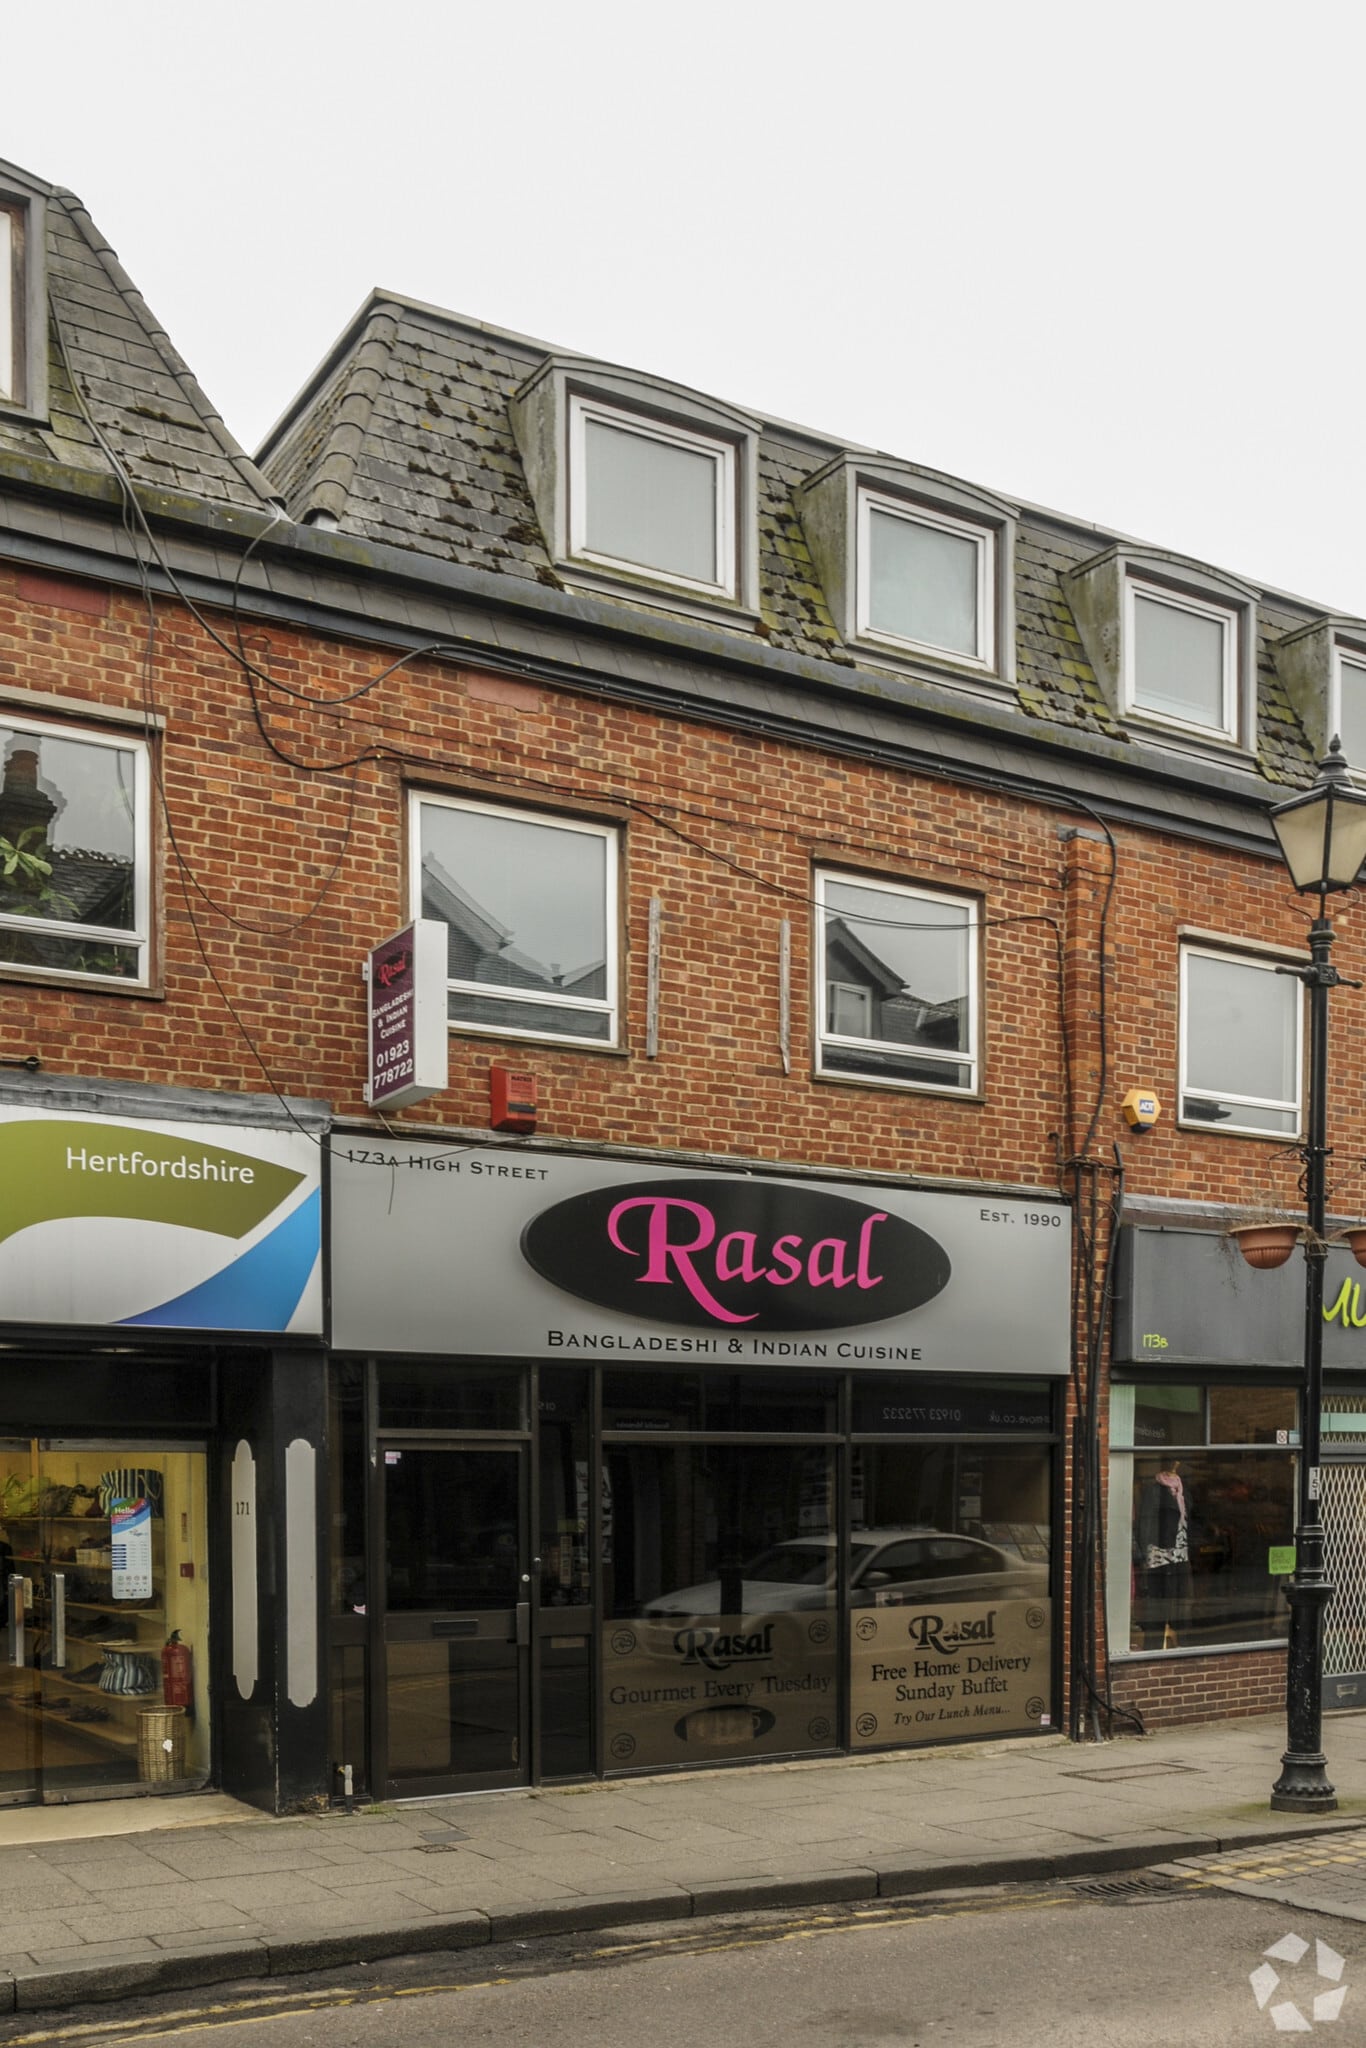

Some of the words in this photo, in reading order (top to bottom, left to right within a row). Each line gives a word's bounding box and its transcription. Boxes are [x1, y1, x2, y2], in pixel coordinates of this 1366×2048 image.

[386, 1005, 408, 1024] INDIAN
[380, 1019, 406, 1039] CUISINE
[376, 1039, 410, 1068] 01923
[374, 1058, 414, 1089] 778722
[66, 1147, 255, 1184] Hertfordshire
[347, 1149, 400, 1168] 173A
[409, 1155, 461, 1174] HIGH
[470, 1161, 549, 1181] STREET
[979, 1208, 1015, 1225] EST.
[1023, 1212, 1062, 1228] 1990
[607, 1196, 888, 1324] Rasal
[547, 1330, 717, 1353] BANGLADESHI
[728, 1338, 743, 1354] &
[753, 1338, 828, 1358] INDIAN
[837, 1342, 922, 1361] CUISINE
[114, 1506, 136, 1515] Hello
[235, 1501, 251, 1516] 171
[673, 1623, 775, 1671] Rasal
[871, 1664, 907, 1682] Free
[913, 1660, 961, 1678] Home
[967, 1655, 1031, 1673] Delivery
[609, 1685, 697, 1705] Gourmet
[704, 1680, 755, 1699] Every
[760, 1672, 831, 1694] Tuesday
[895, 1684, 955, 1702] Sunday
[961, 1676, 1009, 1696] Buffet
[893, 1712, 912, 1726] Try
[915, 1709, 936, 1723] Our
[938, 1706, 970, 1721] Lunch
